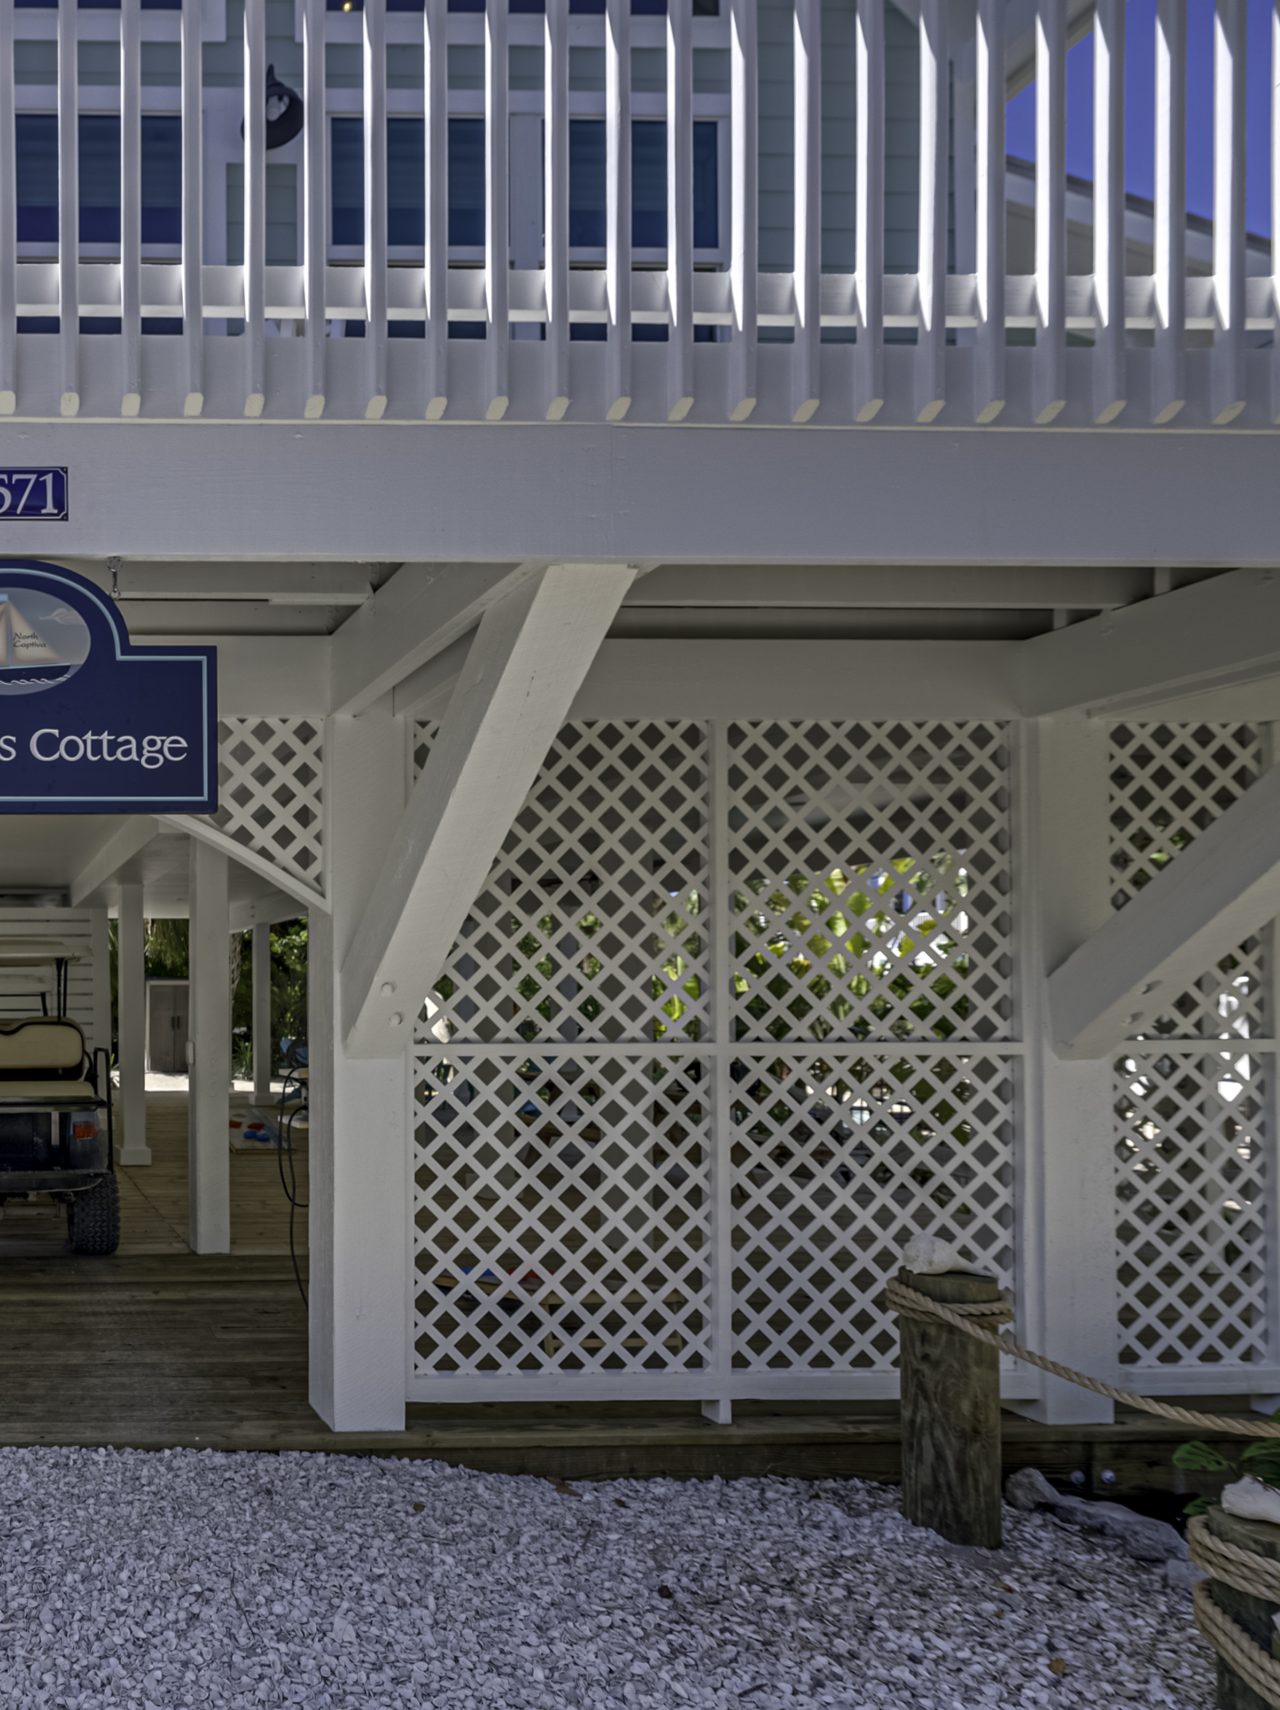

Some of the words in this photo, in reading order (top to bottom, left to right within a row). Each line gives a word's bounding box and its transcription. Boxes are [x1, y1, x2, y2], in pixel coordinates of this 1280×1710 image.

[13, 631, 40, 641] North
[12, 640, 48, 650] Captiva
[29, 728, 189, 770] Cottage
